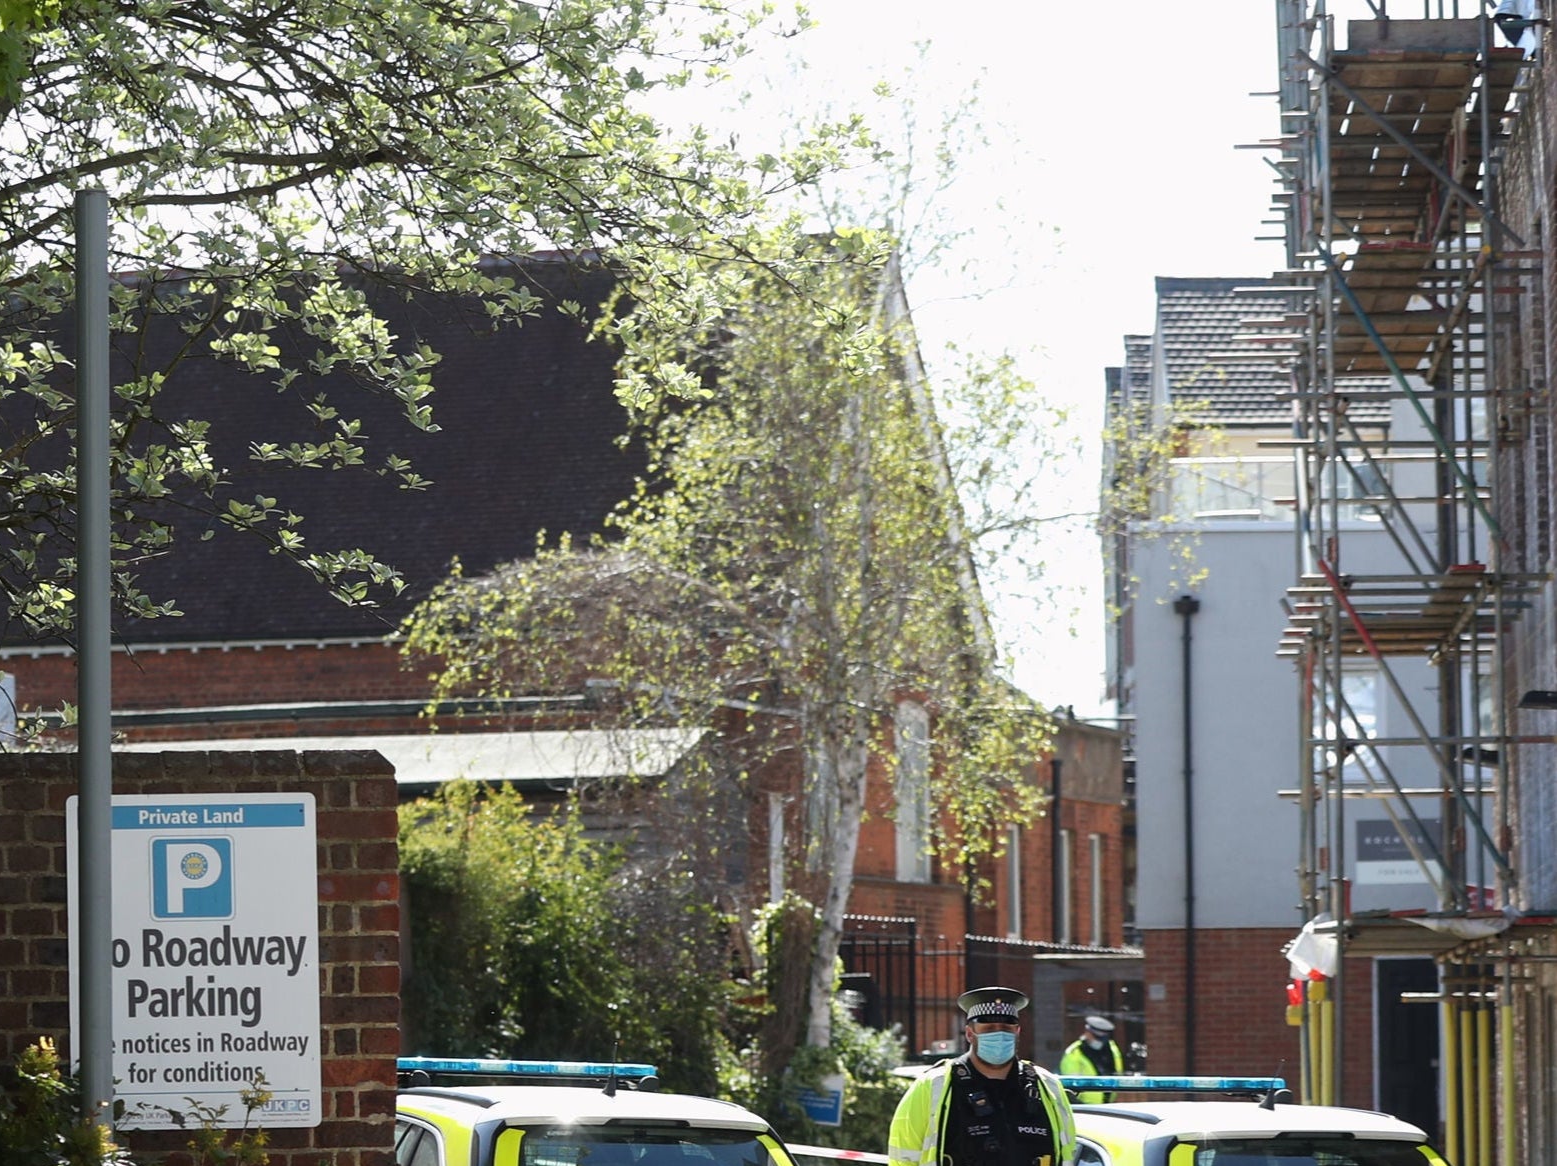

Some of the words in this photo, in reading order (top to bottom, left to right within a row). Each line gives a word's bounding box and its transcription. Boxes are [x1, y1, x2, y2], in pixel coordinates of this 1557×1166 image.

[138, 808, 198, 825] Private
[203, 806, 244, 824] Land
[112, 938, 131, 968] o
[142, 925, 307, 976] Roadway
[127, 976, 261, 1027] Parking
[122, 1033, 191, 1054] notices
[197, 1032, 214, 1052] in
[220, 1031, 309, 1056] Roadway
[128, 1062, 157, 1083] for
[163, 1061, 263, 1083] conditions
[1017, 1126, 1048, 1136] POLICE
